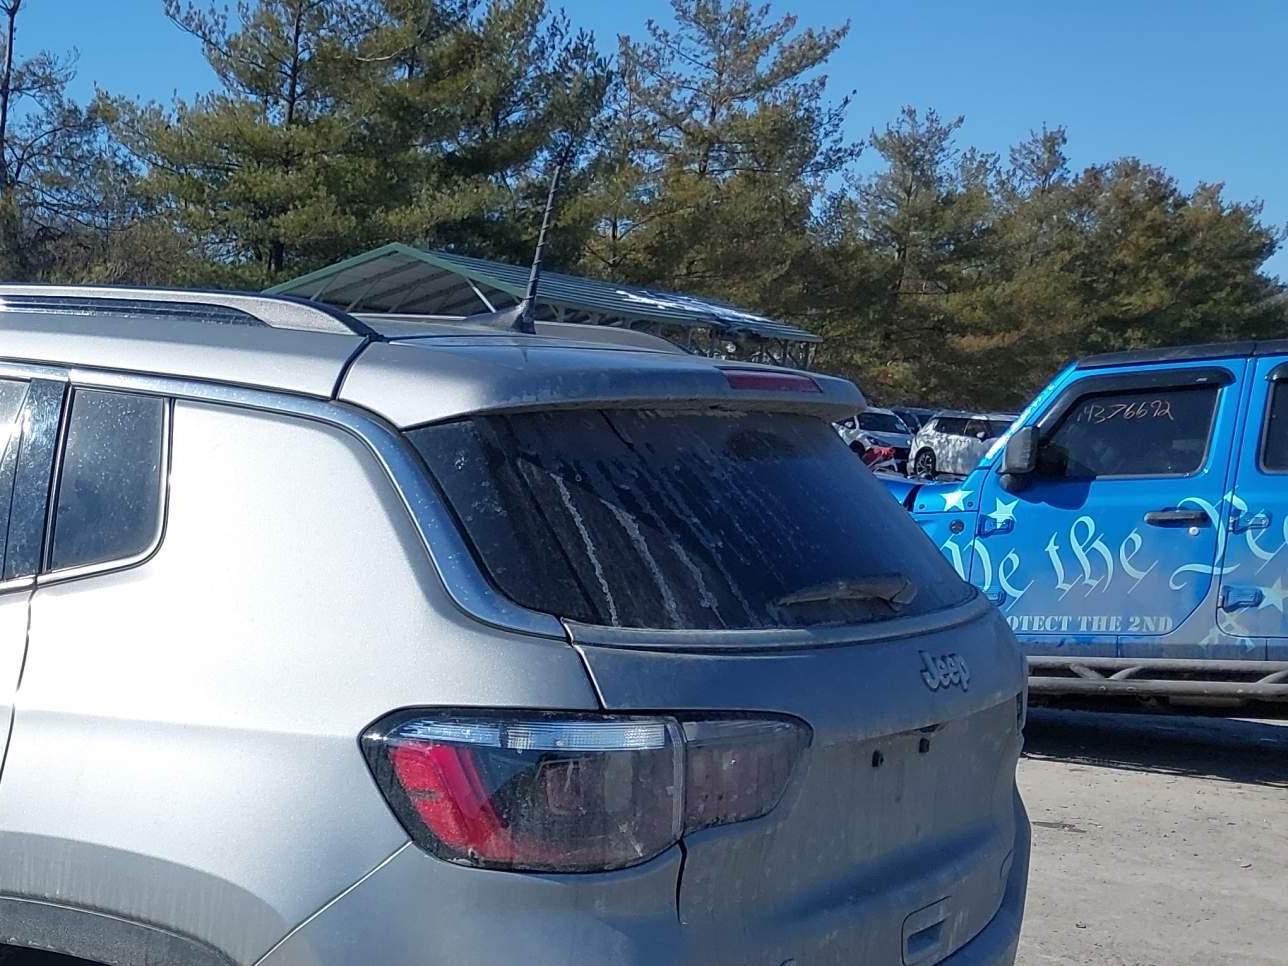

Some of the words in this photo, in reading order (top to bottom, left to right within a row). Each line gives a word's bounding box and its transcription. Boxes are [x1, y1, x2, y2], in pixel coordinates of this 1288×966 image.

[1044, 515, 1159, 601] the
[1165, 487, 1288, 591] Pe
[1006, 615, 1072, 632] OTECT
[1078, 615, 1122, 632] THE
[1127, 616, 1173, 632] 2ND
[918, 650, 971, 692] Jeep
